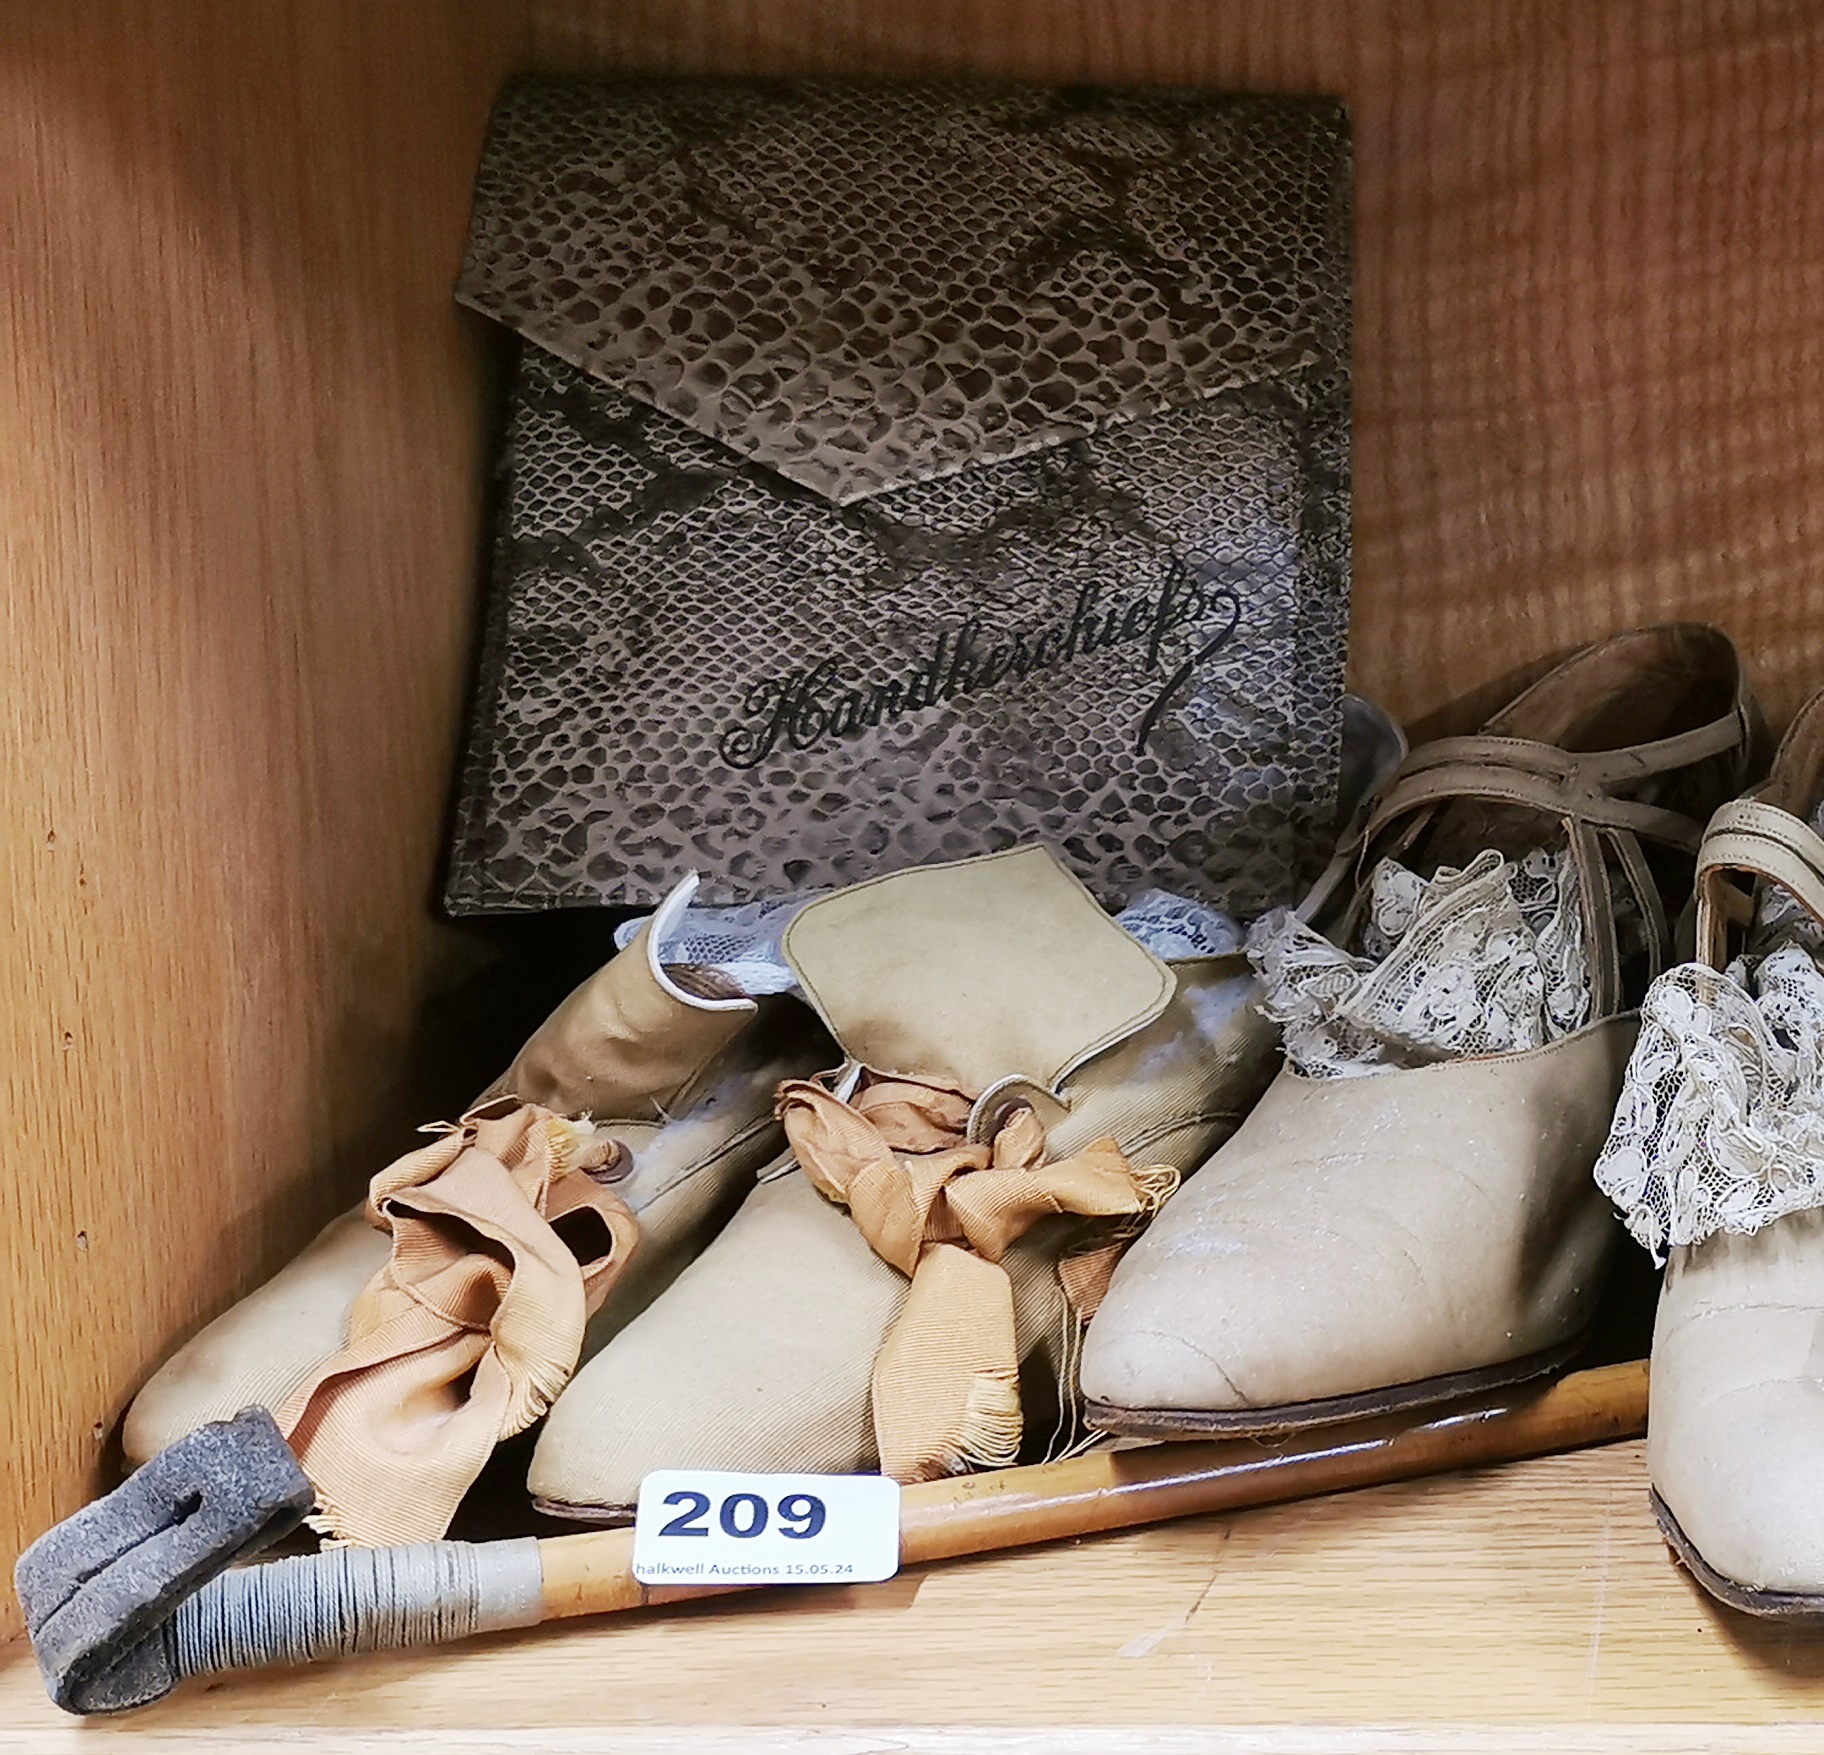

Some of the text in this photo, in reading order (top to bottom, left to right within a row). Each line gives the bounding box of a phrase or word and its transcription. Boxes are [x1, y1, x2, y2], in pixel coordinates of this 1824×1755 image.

[719, 554, 1241, 770] Handkerchiefs
[658, 1490, 827, 1540] 209
[633, 1562, 854, 1576] halkwell Auctions 15.05.24
